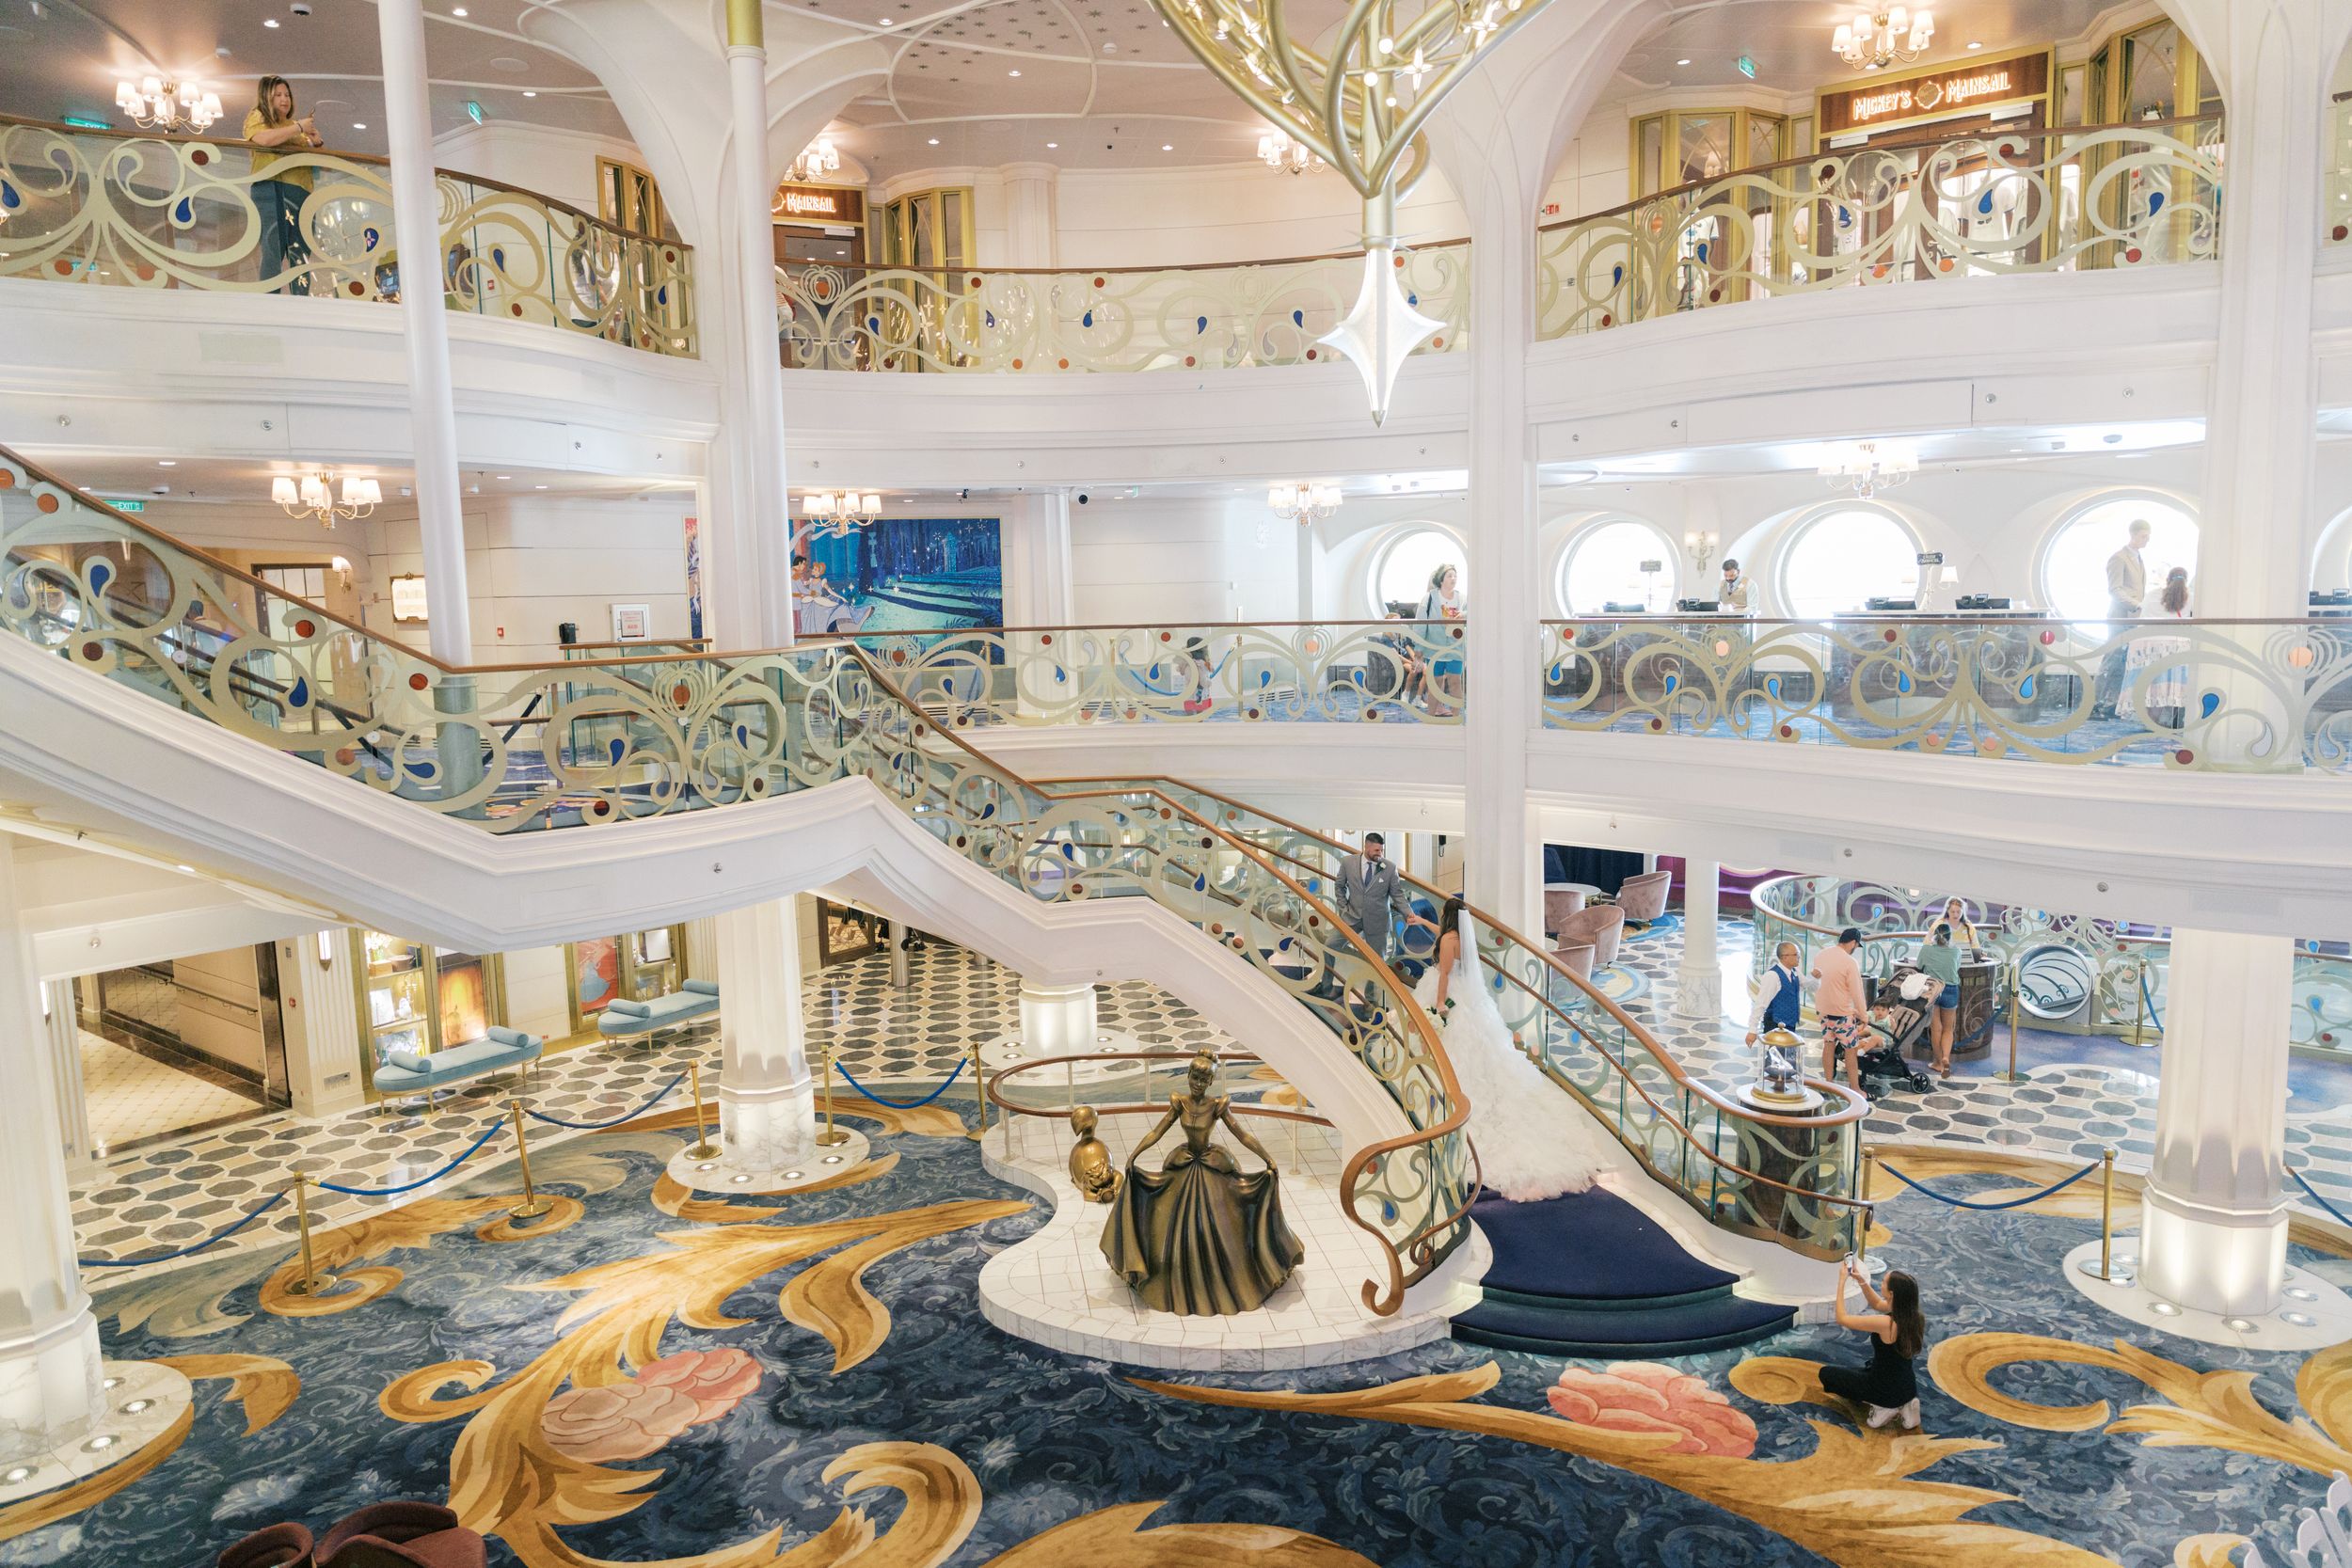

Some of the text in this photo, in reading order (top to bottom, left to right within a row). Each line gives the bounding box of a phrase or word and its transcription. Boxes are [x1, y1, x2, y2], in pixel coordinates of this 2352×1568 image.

[1852, 89, 1912, 120] MICKEY'S
[1946, 71, 2012, 103] MAINSAIL
[787, 192, 837, 214] MAINSAIL
[119, 501, 133, 511] EXIT
